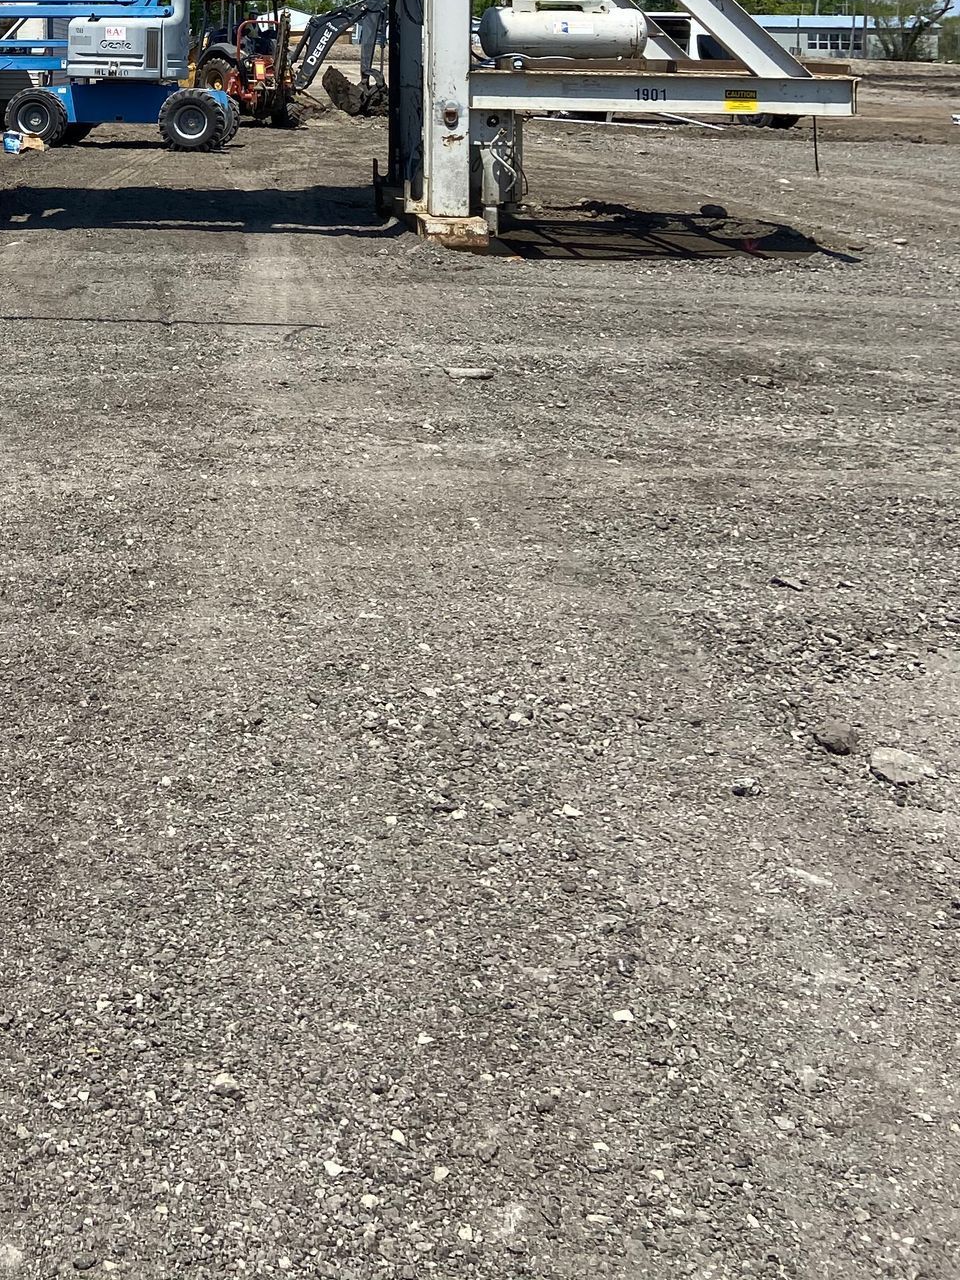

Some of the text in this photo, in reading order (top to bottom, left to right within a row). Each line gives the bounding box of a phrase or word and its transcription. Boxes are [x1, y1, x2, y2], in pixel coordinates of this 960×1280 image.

[100, 40, 132, 50] Genie
[306, 28, 333, 66] DEERE
[634, 87, 667, 101] 1901
[726, 90, 756, 98] CAUTION
